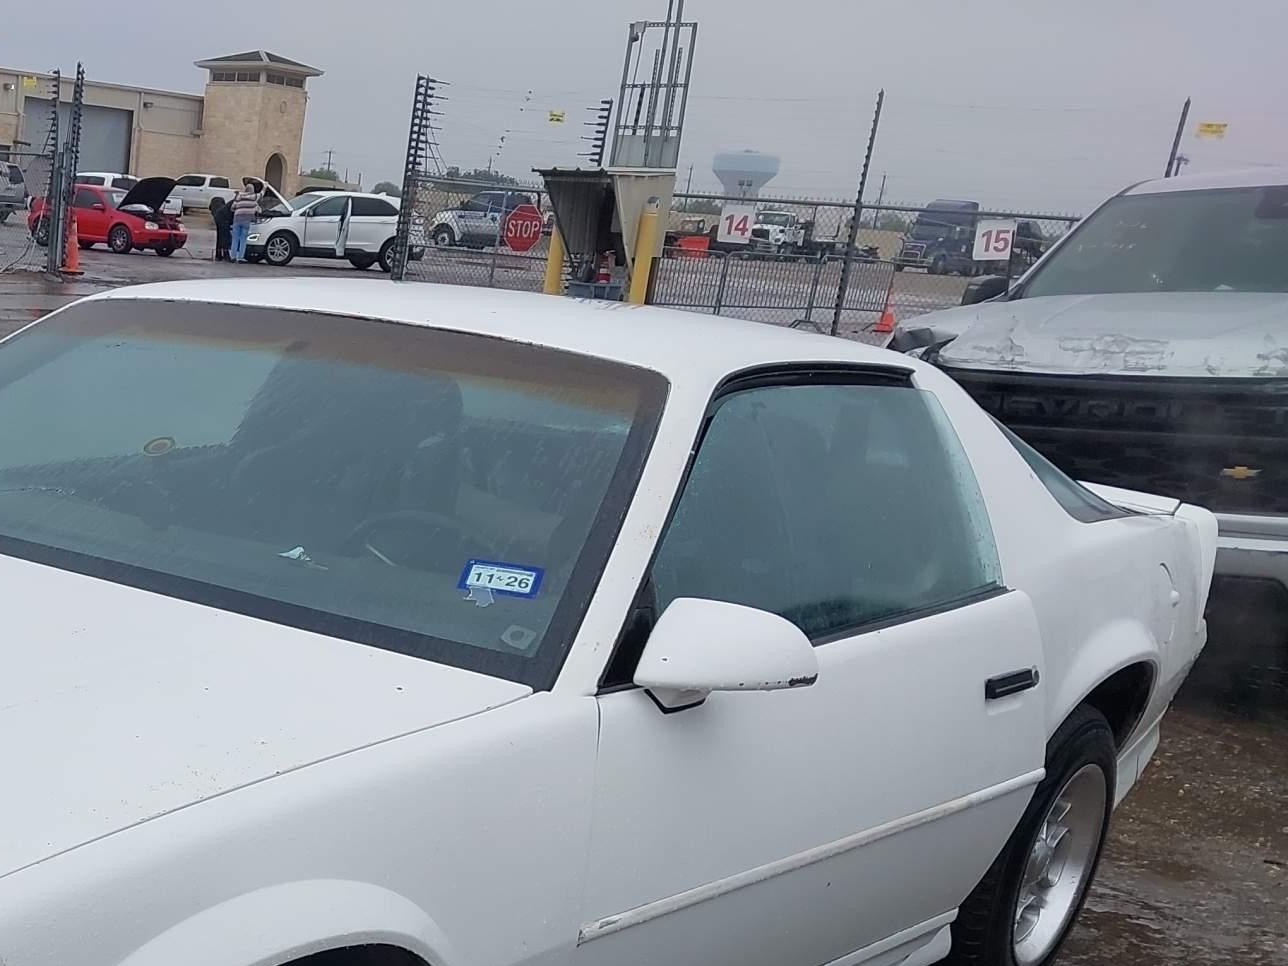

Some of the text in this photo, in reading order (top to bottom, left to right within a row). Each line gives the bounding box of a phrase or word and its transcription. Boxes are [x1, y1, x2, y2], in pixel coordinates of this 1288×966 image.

[507, 220, 540, 238] STOP
[725, 213, 749, 236] 14
[981, 229, 1010, 252] 15
